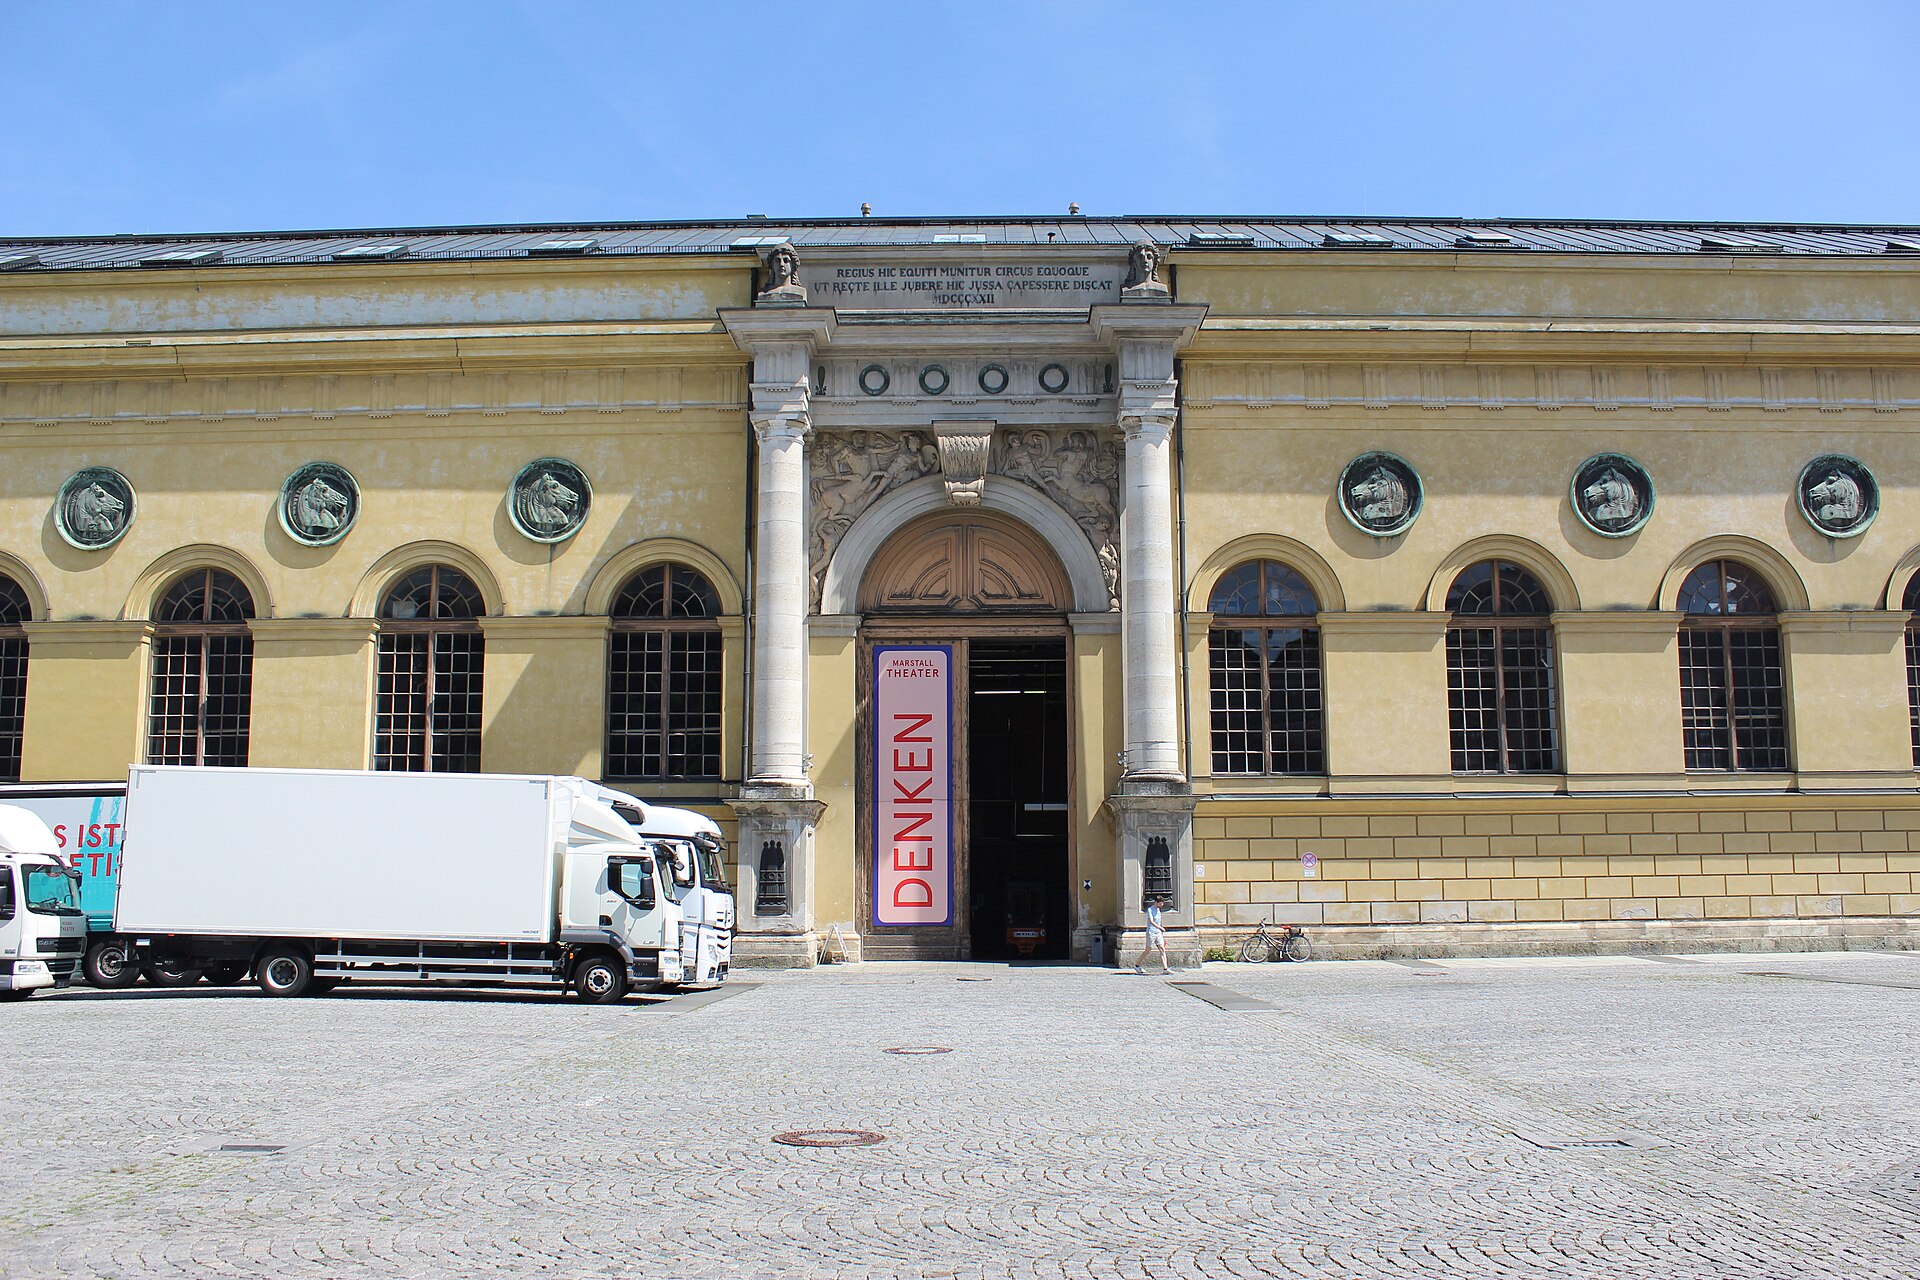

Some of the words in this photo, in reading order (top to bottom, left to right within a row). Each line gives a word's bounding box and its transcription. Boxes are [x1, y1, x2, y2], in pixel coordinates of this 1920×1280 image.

[837, 268, 875, 278] REGIUS
[878, 268, 896, 278] HIC
[900, 268, 937, 277] EQUITI
[940, 267, 991, 277] MUNITUR
[996, 267, 1033, 277] CIRCUS
[1037, 267, 1089, 277] EQUOQUE
[814, 282, 830, 293] UT
[833, 281, 870, 293] RECTE
[873, 281, 897, 291] ILLE
[900, 281, 943, 291] JUBERE
[946, 281, 965, 291] HIC
[968, 281, 1003, 291] JUSSA
[1007, 280, 1070, 291] CAPESSERE
[1073, 280, 1113, 291] DISCAT
[892, 659, 934, 667] MARSTALL
[886, 668, 940, 678] THEATER
[893, 713, 933, 908] DENKEN
[77, 823, 121, 848] IST
[69, 853, 119, 877] ETI
